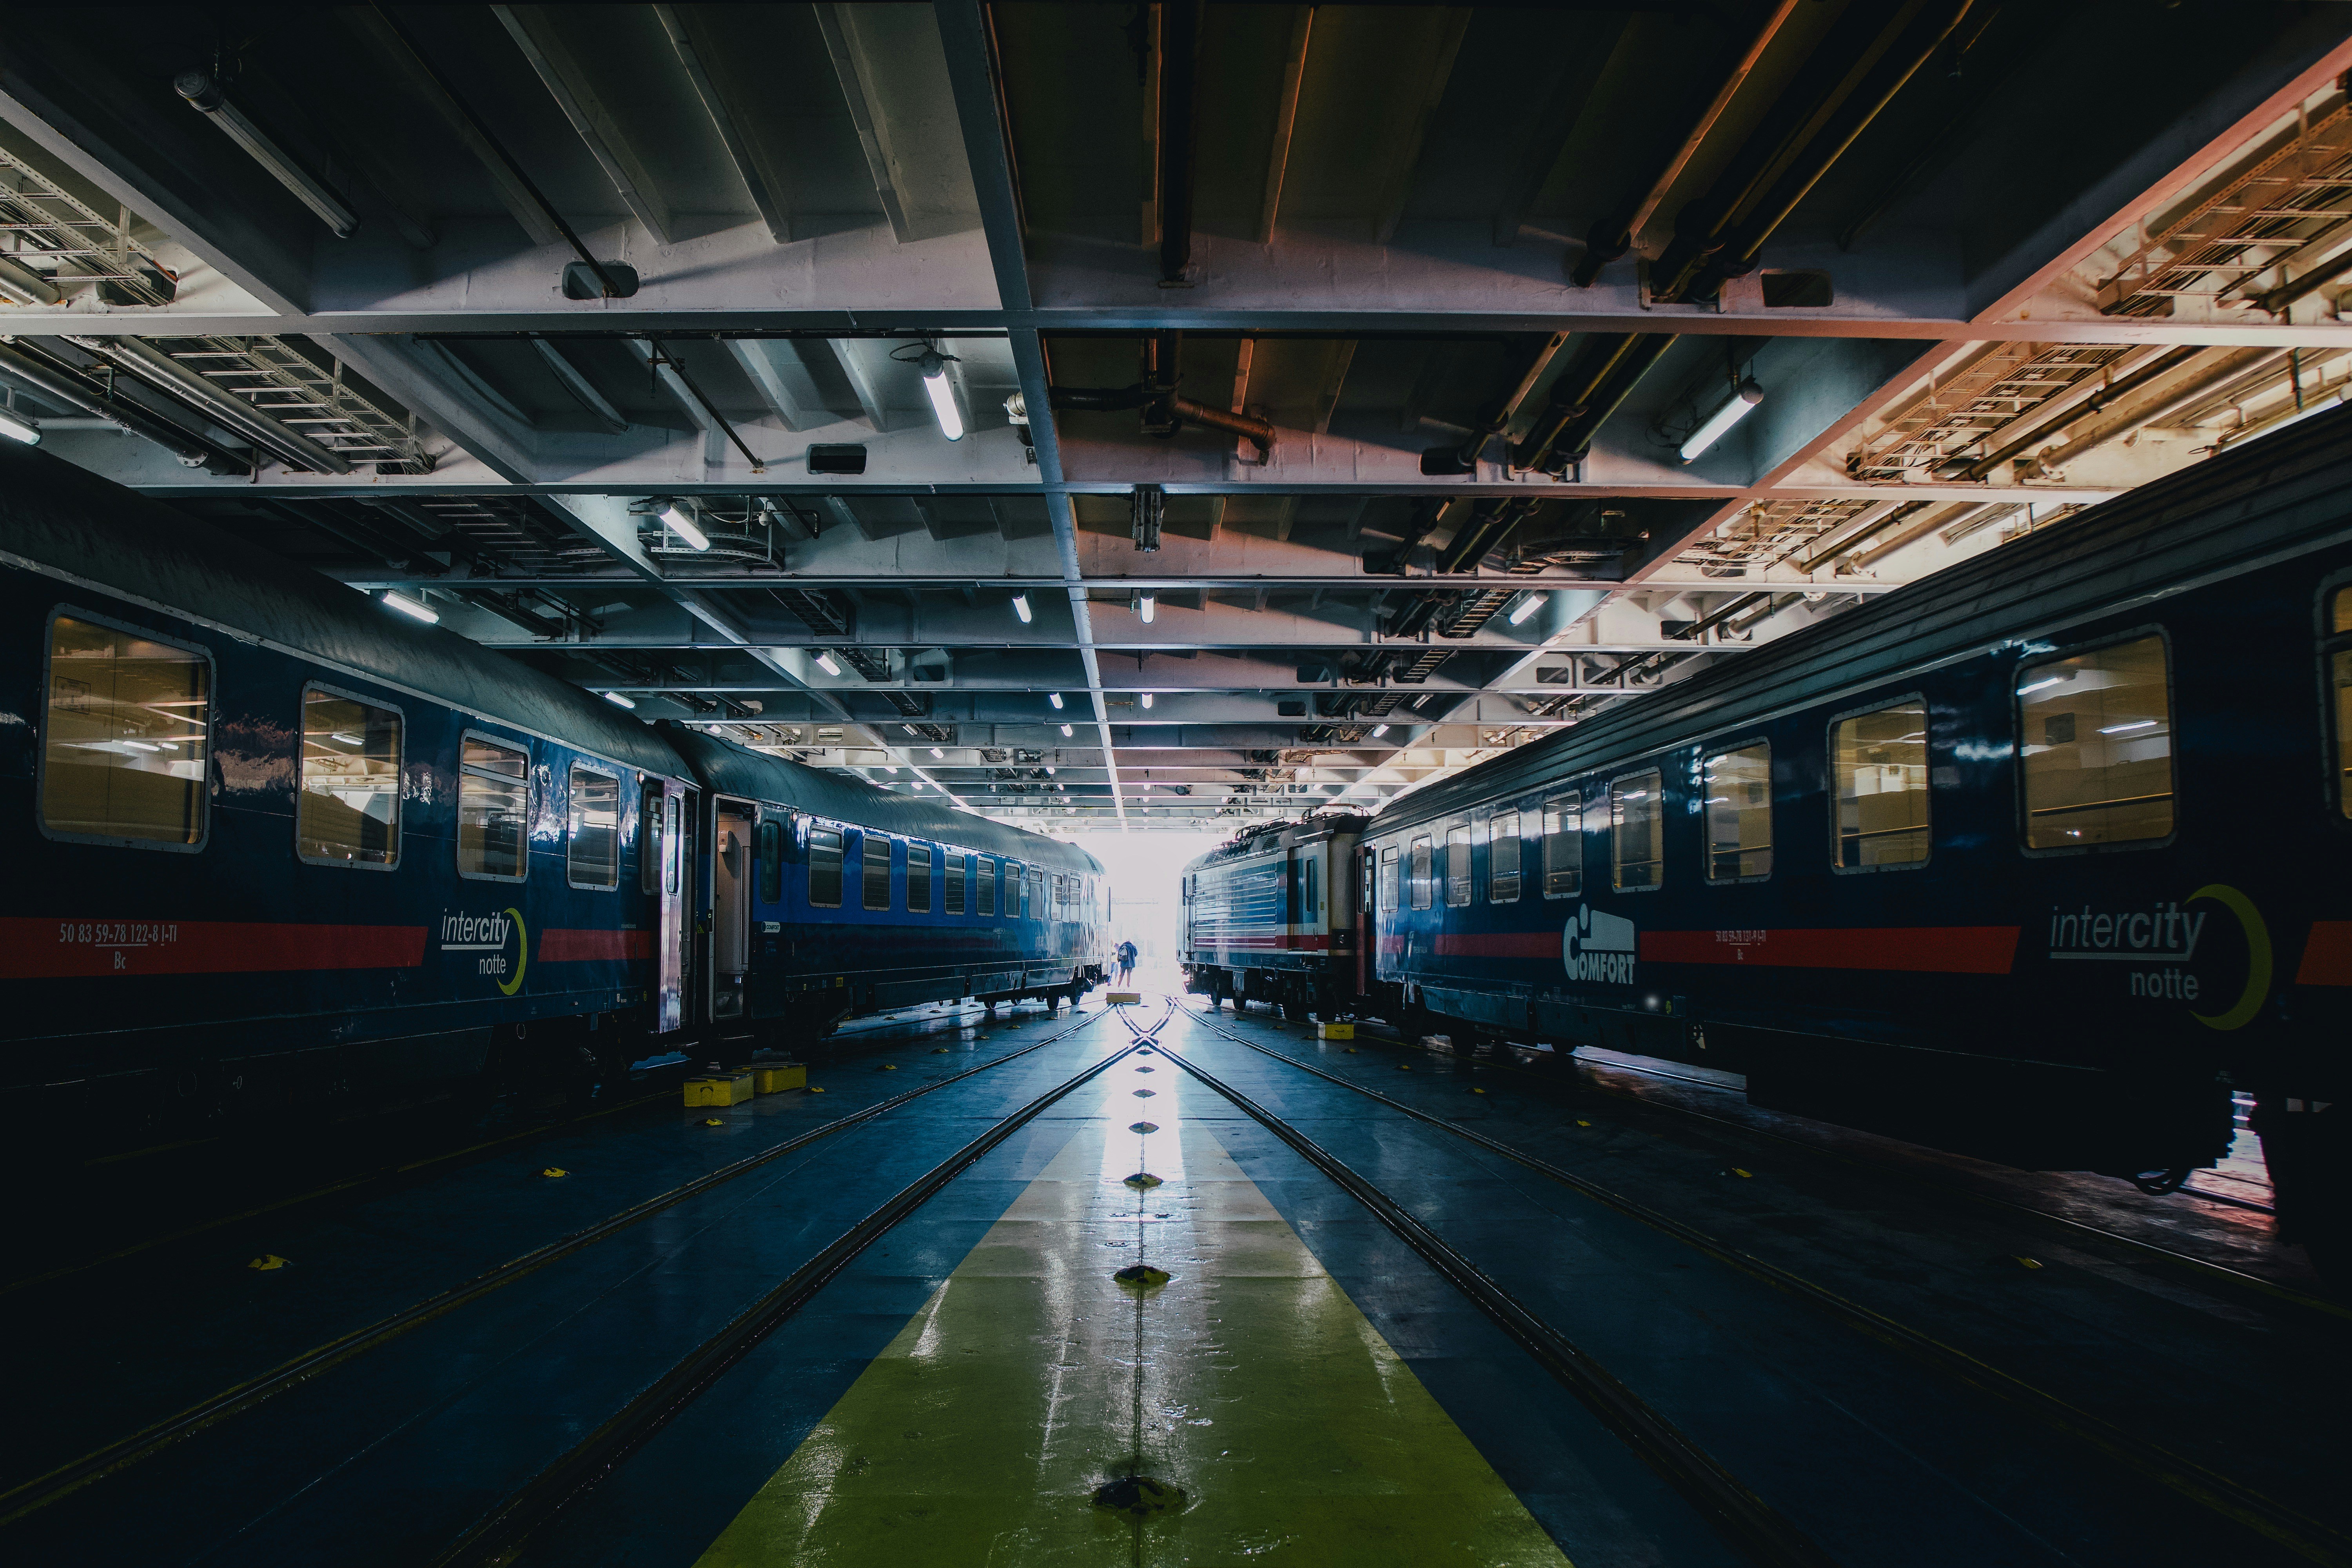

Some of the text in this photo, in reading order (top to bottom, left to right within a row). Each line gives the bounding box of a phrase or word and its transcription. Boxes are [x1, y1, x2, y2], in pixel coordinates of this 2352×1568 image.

[59, 923, 74, 942] 50
[78, 924, 92, 943] 83
[95, 924, 126, 942] 59-78
[131, 924, 158, 942] 122-8
[441, 908, 510, 949] intercity
[2050, 902, 2206, 961] intercity
[114, 951, 126, 969] Bc
[479, 954, 506, 975] notte
[1563, 916, 1635, 984] COMFORT
[2130, 968, 2199, 1000] notte
